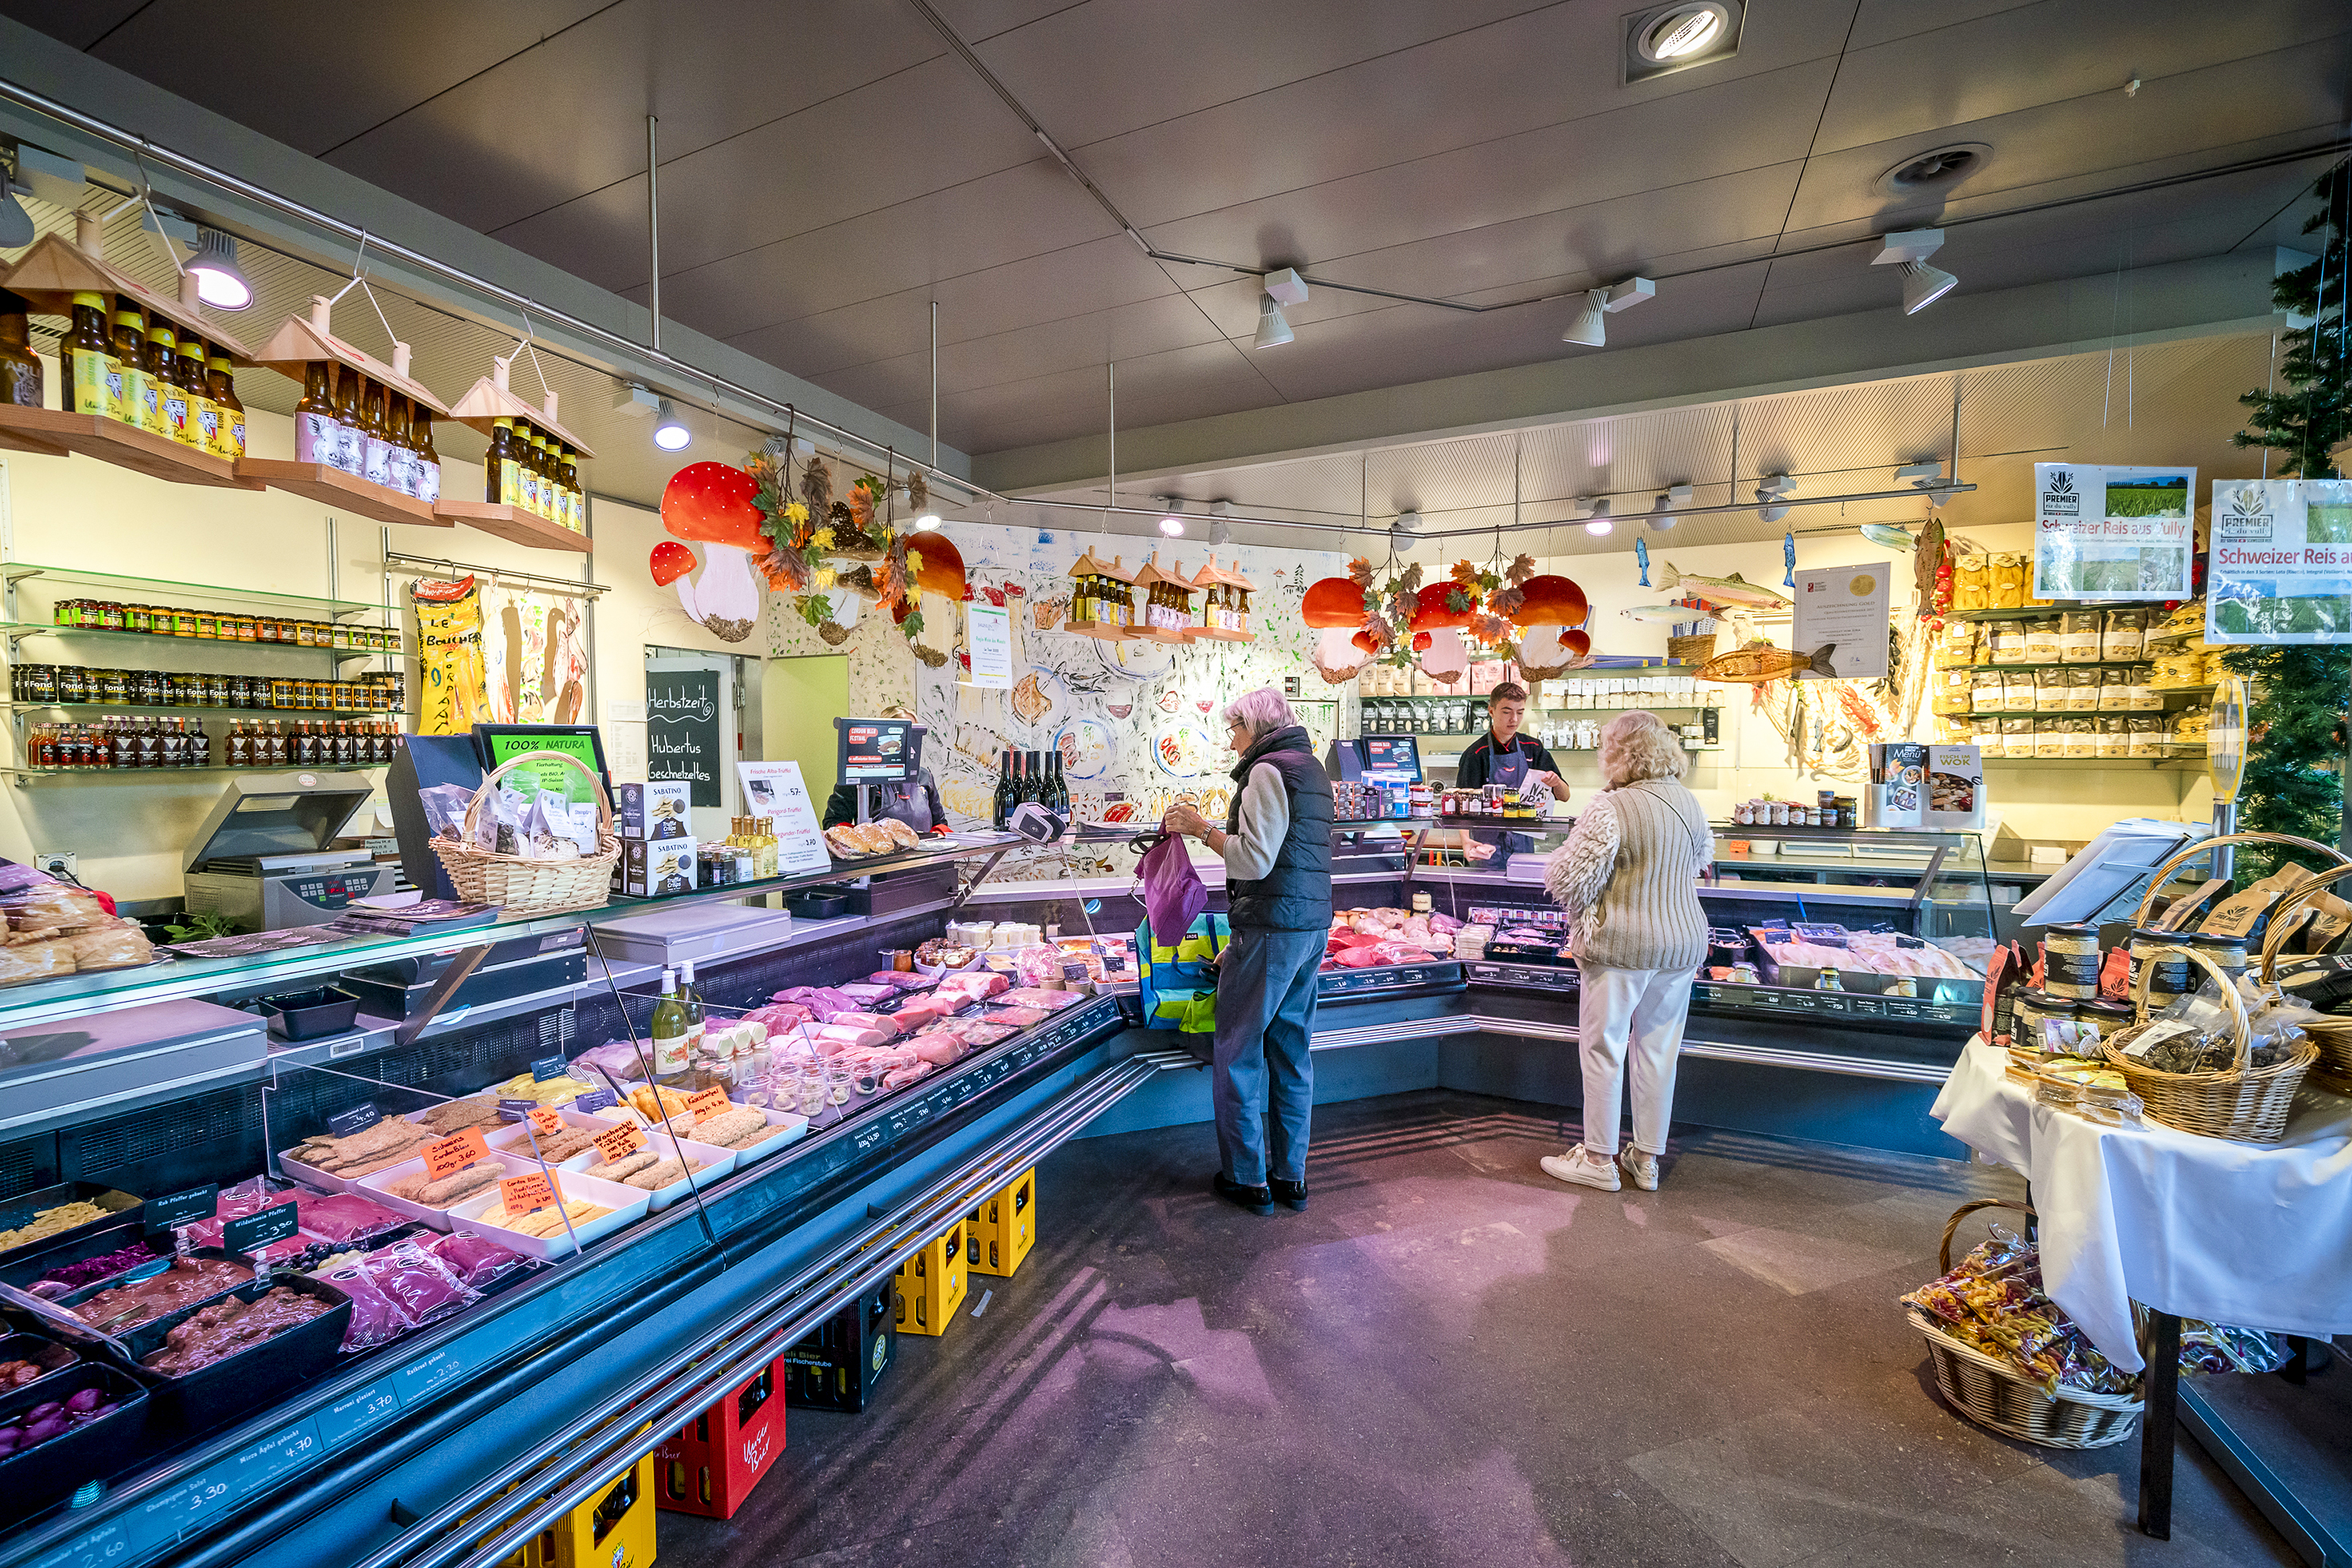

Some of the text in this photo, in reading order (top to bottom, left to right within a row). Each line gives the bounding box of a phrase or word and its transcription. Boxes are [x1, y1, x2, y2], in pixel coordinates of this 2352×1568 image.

[2045, 495, 2077, 503] PREMIER
[2042, 519, 2100, 534] Scheizer
[2103, 521, 2128, 534] Reis
[2131, 524, 2151, 534] aus
[2225, 518, 2270, 527] PREMIER
[2250, 527, 2270, 536] vully
[2218, 548, 2336, 565] Schweizer Reis
[61, 682, 83, 690] Fond
[648, 685, 708, 709] Herbstzeit
[505, 740, 585, 750] 100% NATURA
[651, 731, 702, 754] Hubertus
[1893, 749, 1921, 758] Menü
[648, 760, 710, 781] Geschnetzeltes
[658, 843, 687, 853] SABATINO
[593, 1120, 633, 1144] Wochenhit
[458, 1149, 476, 1163] 3.60
[170, 1195, 188, 1204] Pfeffer
[189, 1189, 208, 1200] gekocht
[235, 1208, 287, 1228] Wildschwein Pfeffer
[428, 1351, 446, 1367] gekocht
[792, 1358, 832, 1367] Fischerstube
[799, 1351, 821, 1360] Bier
[367, 1394, 393, 1415] 3.70
[276, 1429, 299, 1446] gekocht
[743, 1421, 769, 1463] Unser
[285, 1436, 313, 1458] 4.70
[747, 1435, 771, 1474] Bier
[189, 1478, 207, 1491] Salat
[189, 1483, 227, 1511] 3.30
